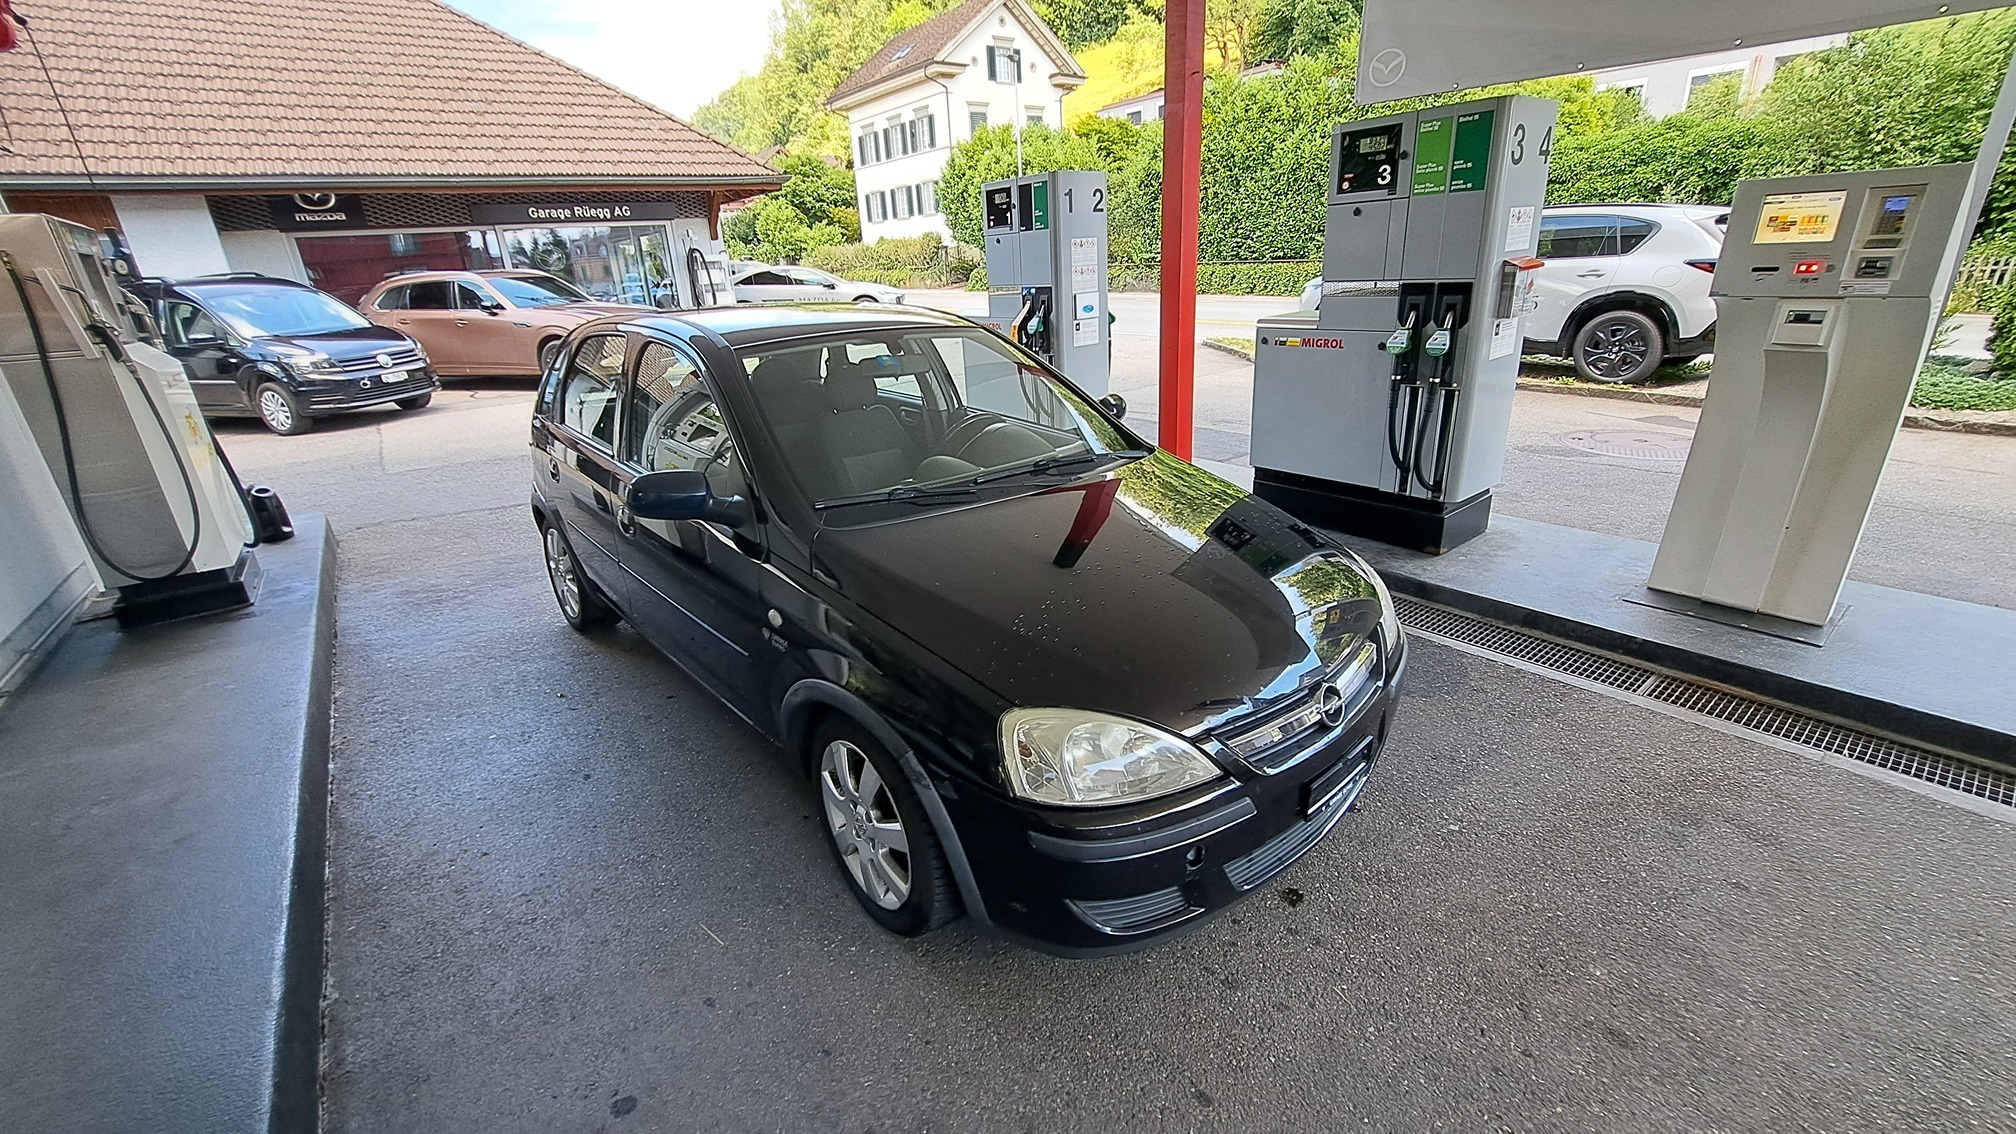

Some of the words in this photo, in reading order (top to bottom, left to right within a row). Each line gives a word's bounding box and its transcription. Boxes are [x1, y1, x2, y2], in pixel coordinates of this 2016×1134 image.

[1510, 123, 1526, 166] 3
[1538, 125, 1552, 165] 4
[1377, 164, 1391, 185] 3
[1064, 188, 1073, 213] 1
[1092, 188, 1104, 213] 2
[294, 212, 347, 222] mazda
[528, 206, 572, 220] Garage
[573, 205, 611, 219] Rüegg
[613, 205, 631, 217] AG
[1005, 211, 1011, 225] 1
[1301, 338, 1344, 349] MIGROL
